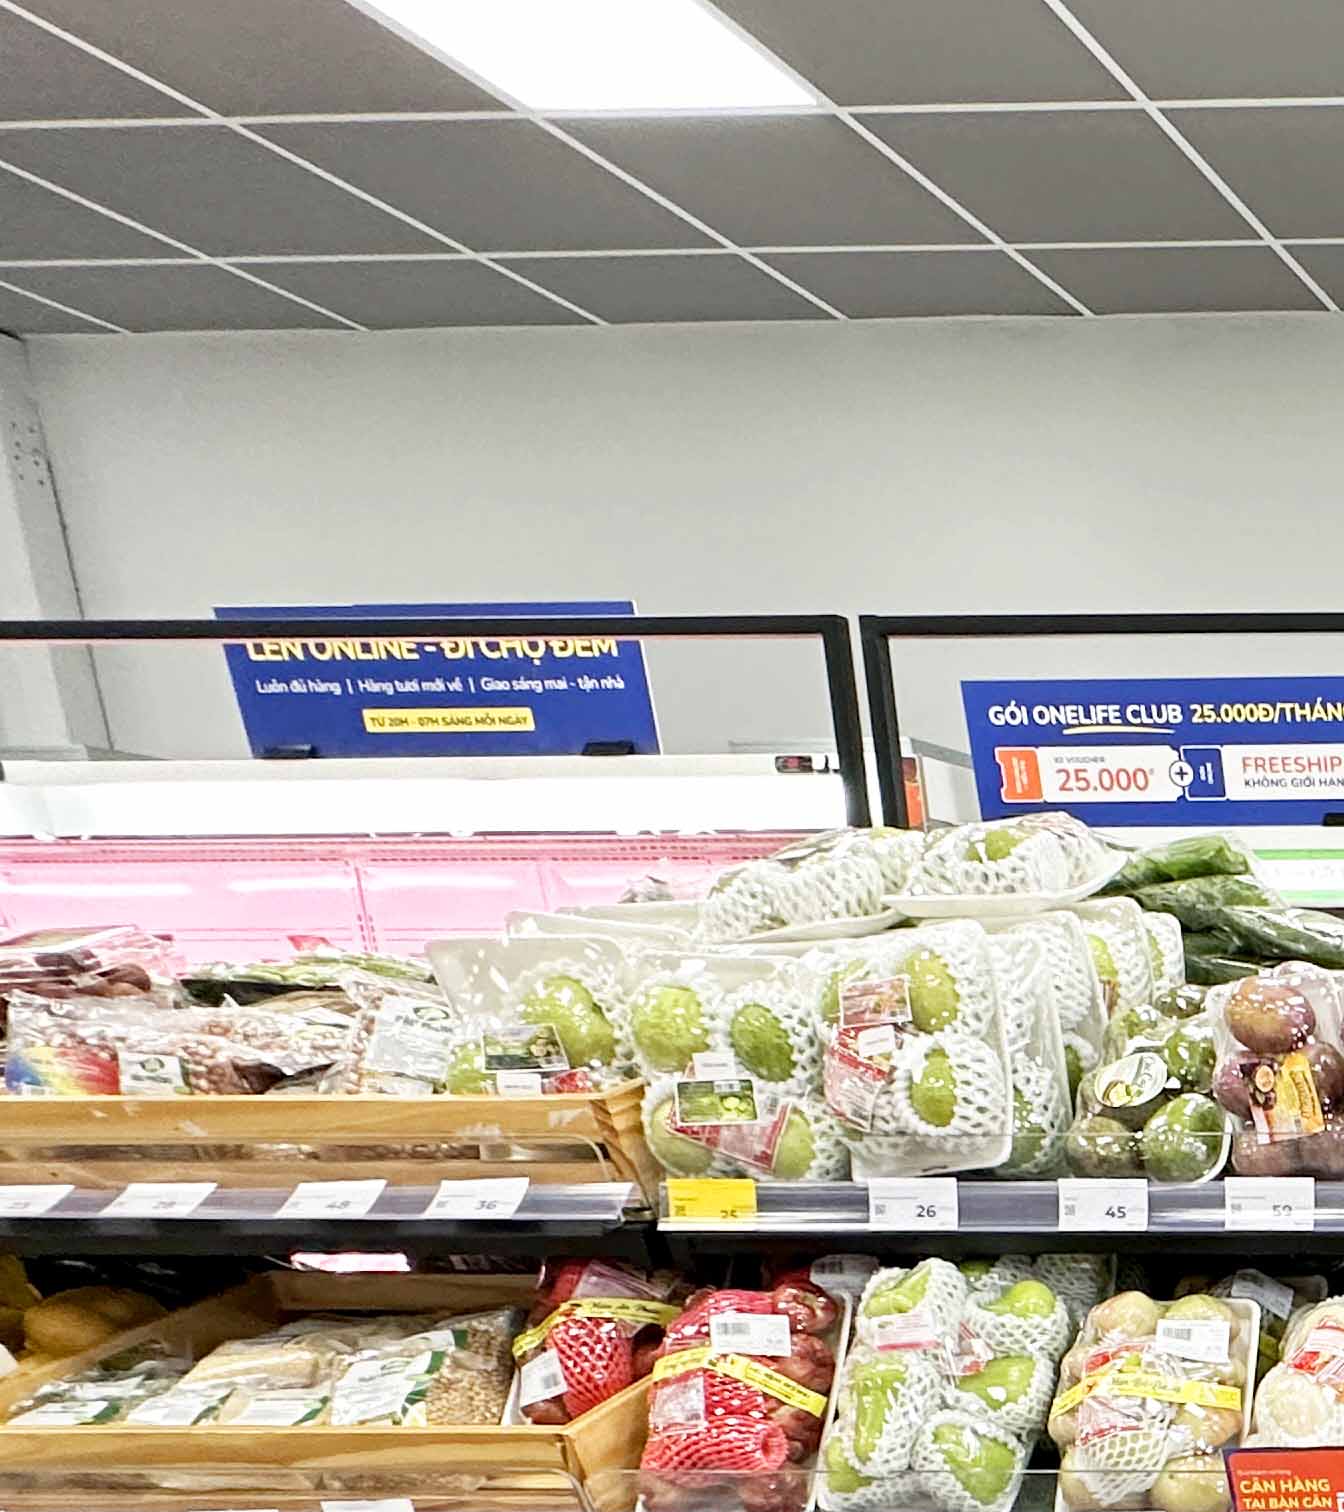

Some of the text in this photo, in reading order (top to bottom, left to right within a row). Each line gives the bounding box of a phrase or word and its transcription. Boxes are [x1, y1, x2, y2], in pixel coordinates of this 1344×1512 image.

[988, 701, 1028, 726] GÓI
[1037, 703, 1121, 726] ONELIFE
[1126, 703, 1183, 725] CLUB
[1242, 756, 1343, 773] FREESHIP
[916, 1204, 936, 1218] 26
[1105, 1206, 1127, 1219] 45
[1280, 1475, 1330, 1493] HÀNG
